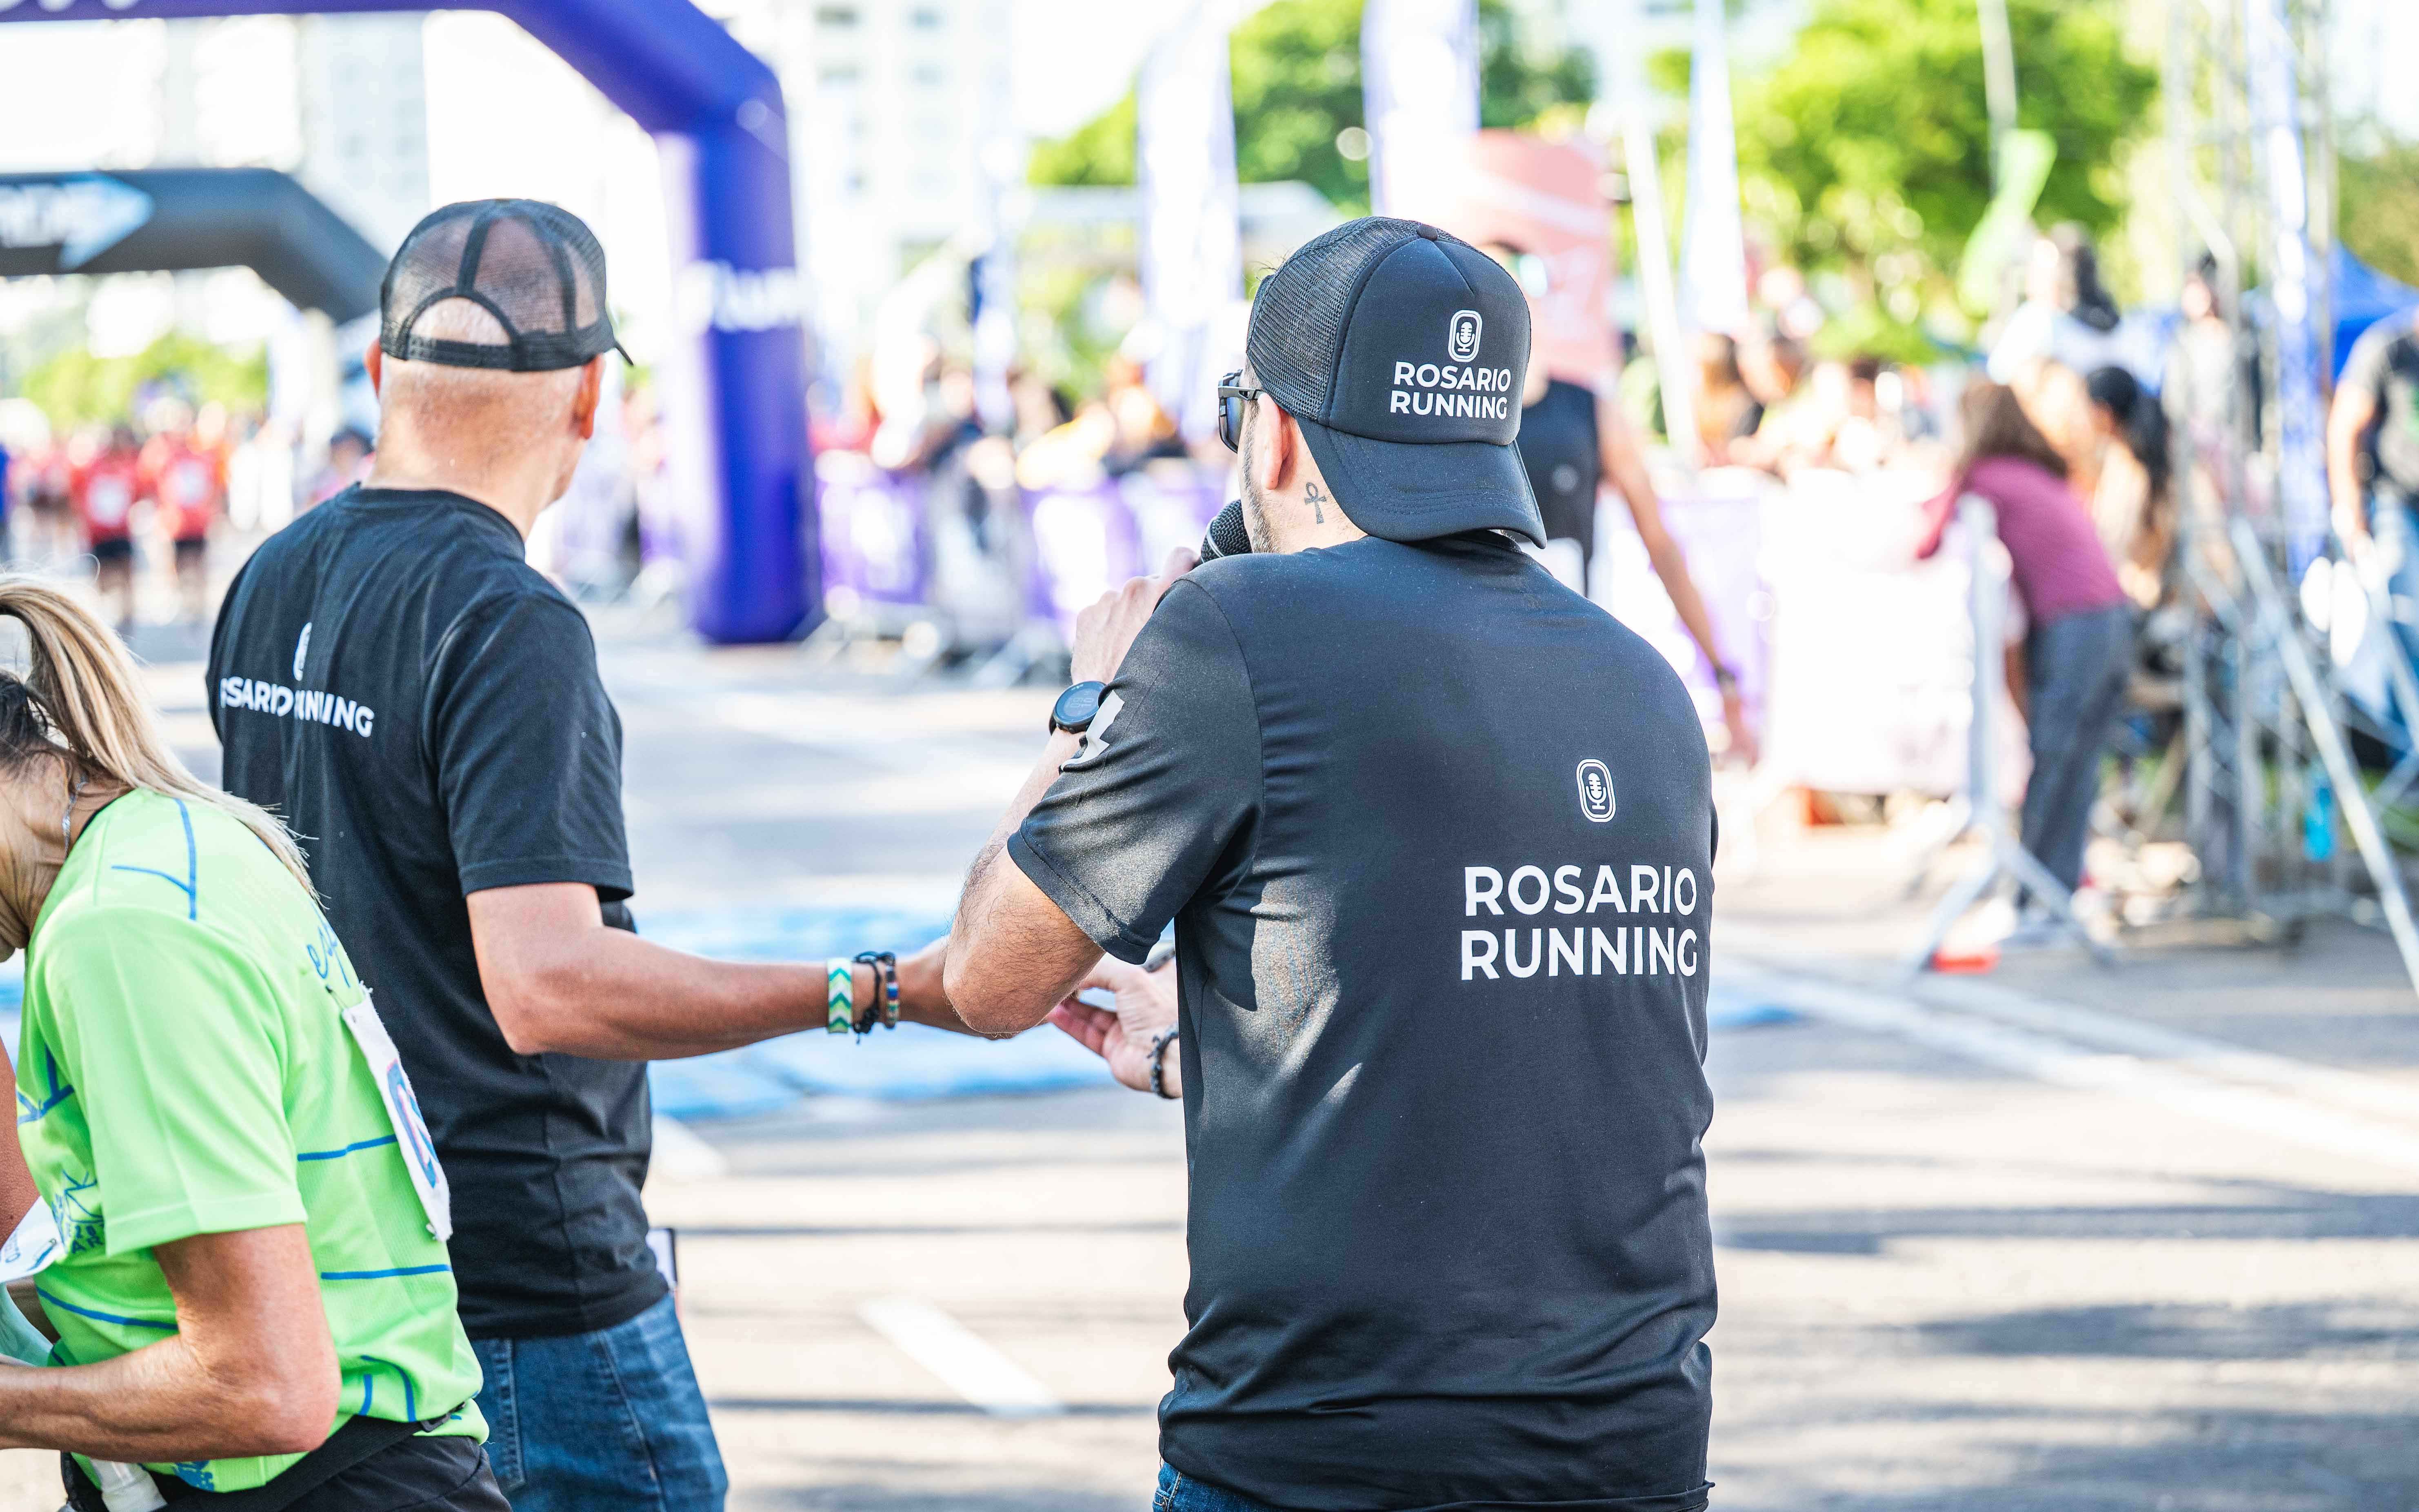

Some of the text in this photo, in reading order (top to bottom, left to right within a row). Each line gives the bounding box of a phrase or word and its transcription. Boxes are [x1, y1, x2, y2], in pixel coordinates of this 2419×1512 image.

[1394, 361, 1511, 392] ROSARIO
[1390, 390, 1508, 420] RUNNING
[1464, 864, 1697, 916] ROSARIO
[1461, 927, 1697, 980] RUNNING
